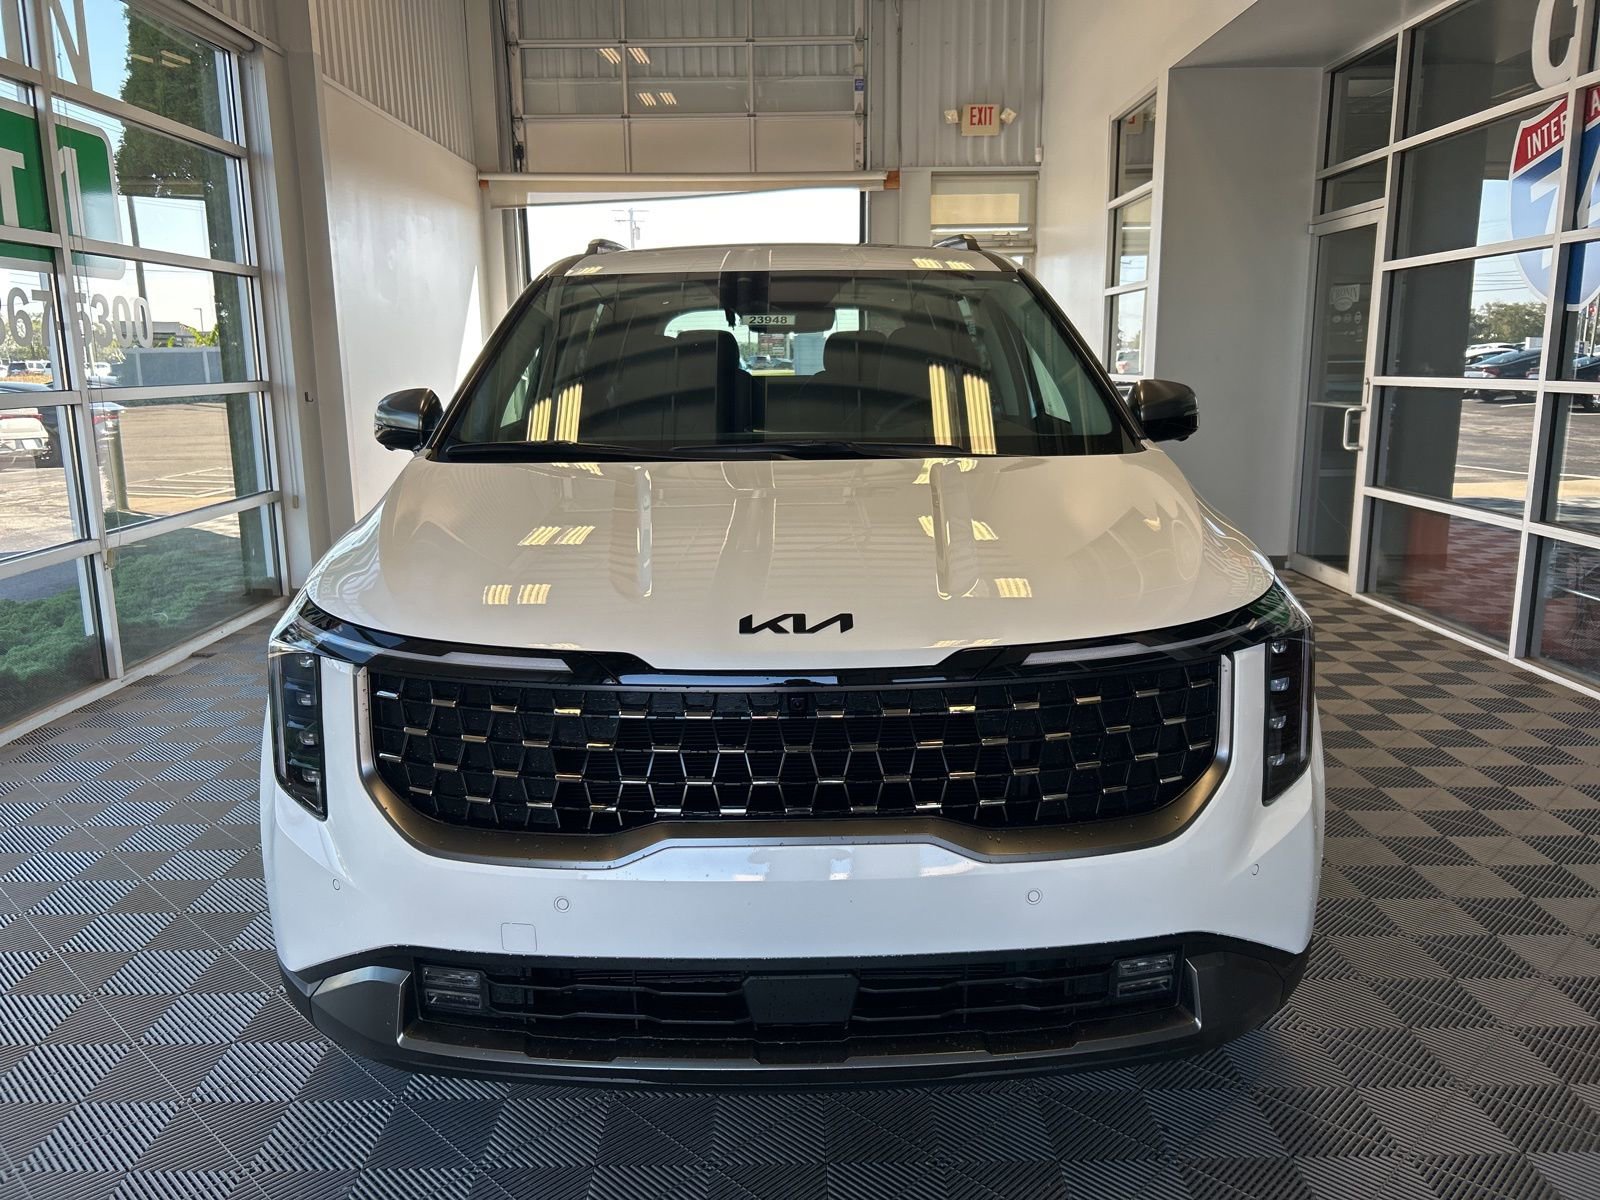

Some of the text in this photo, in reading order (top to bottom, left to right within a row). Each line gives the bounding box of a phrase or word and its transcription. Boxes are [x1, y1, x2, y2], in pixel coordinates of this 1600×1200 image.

[969, 106, 994, 126] EXIT
[748, 316, 788, 324] 23948
[739, 613, 853, 634] KIA
